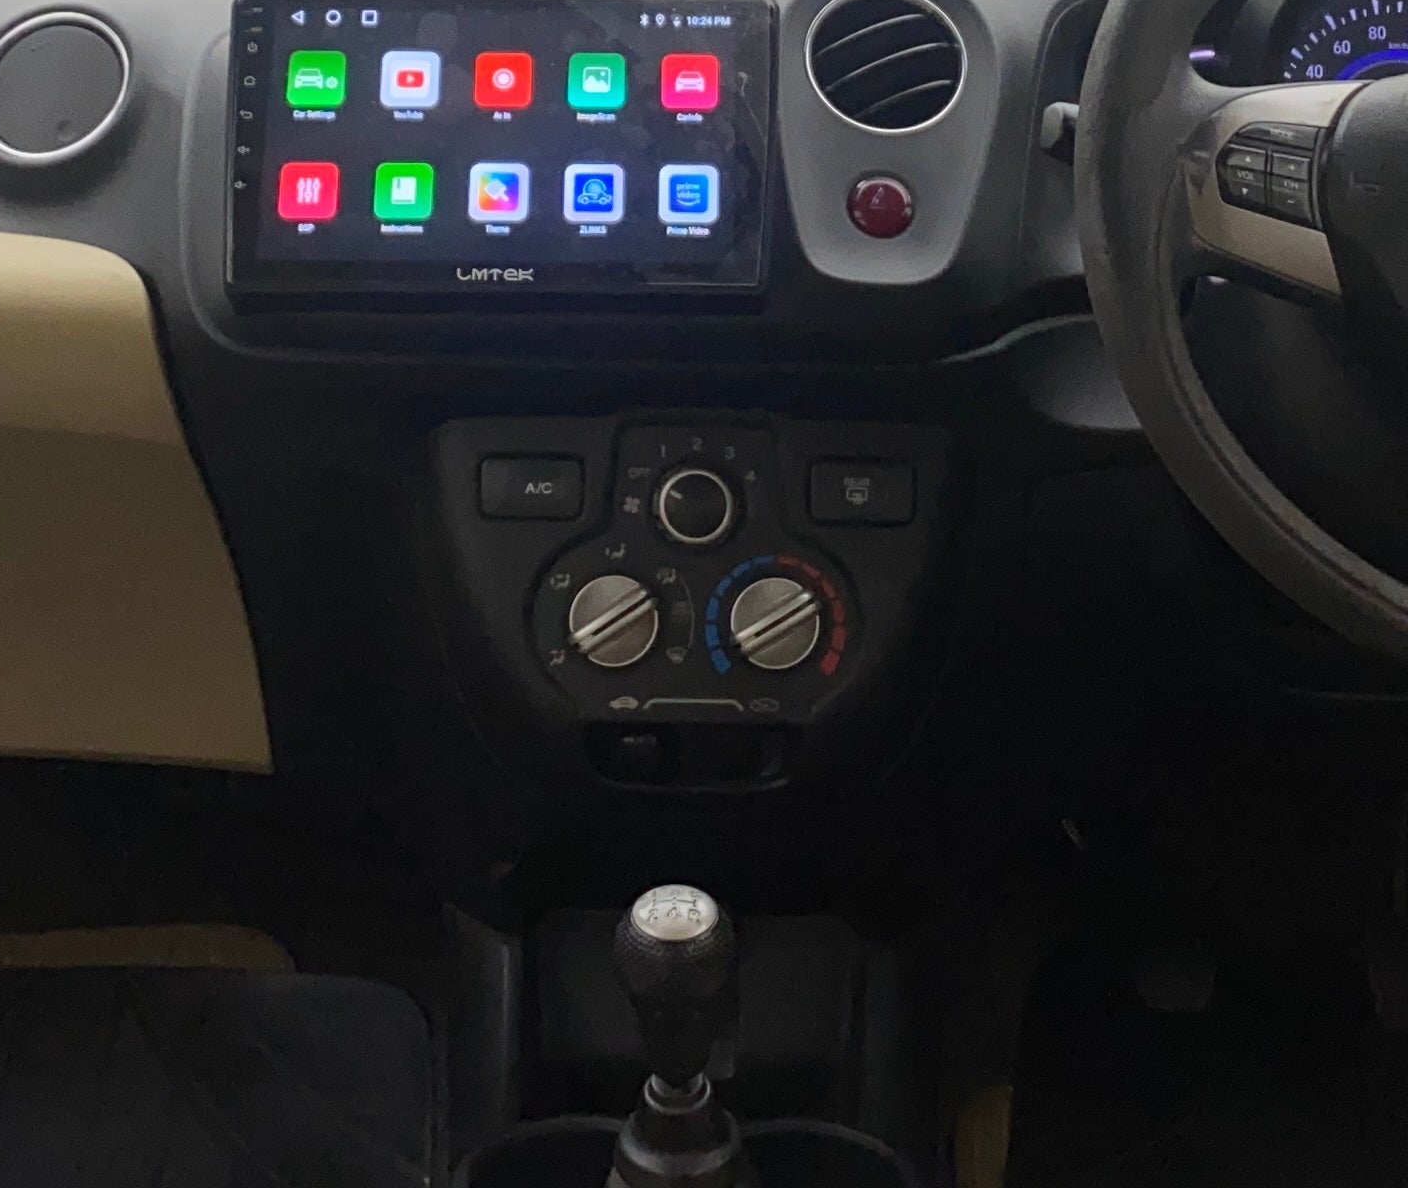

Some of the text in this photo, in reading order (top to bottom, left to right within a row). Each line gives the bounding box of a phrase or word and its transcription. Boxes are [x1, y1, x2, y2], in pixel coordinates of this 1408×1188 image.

[714, 15, 732, 26] PM
[1368, 26, 1387, 40] 80
[1333, 40, 1351, 55] 60
[1388, 42, 1408, 51] km/h
[1305, 64, 1324, 79] 40
[660, 444, 667, 458] 1
[692, 437, 703, 451] 2
[724, 446, 736, 460] 3
[744, 470, 756, 481] 4
[525, 482, 553, 494] A/C
